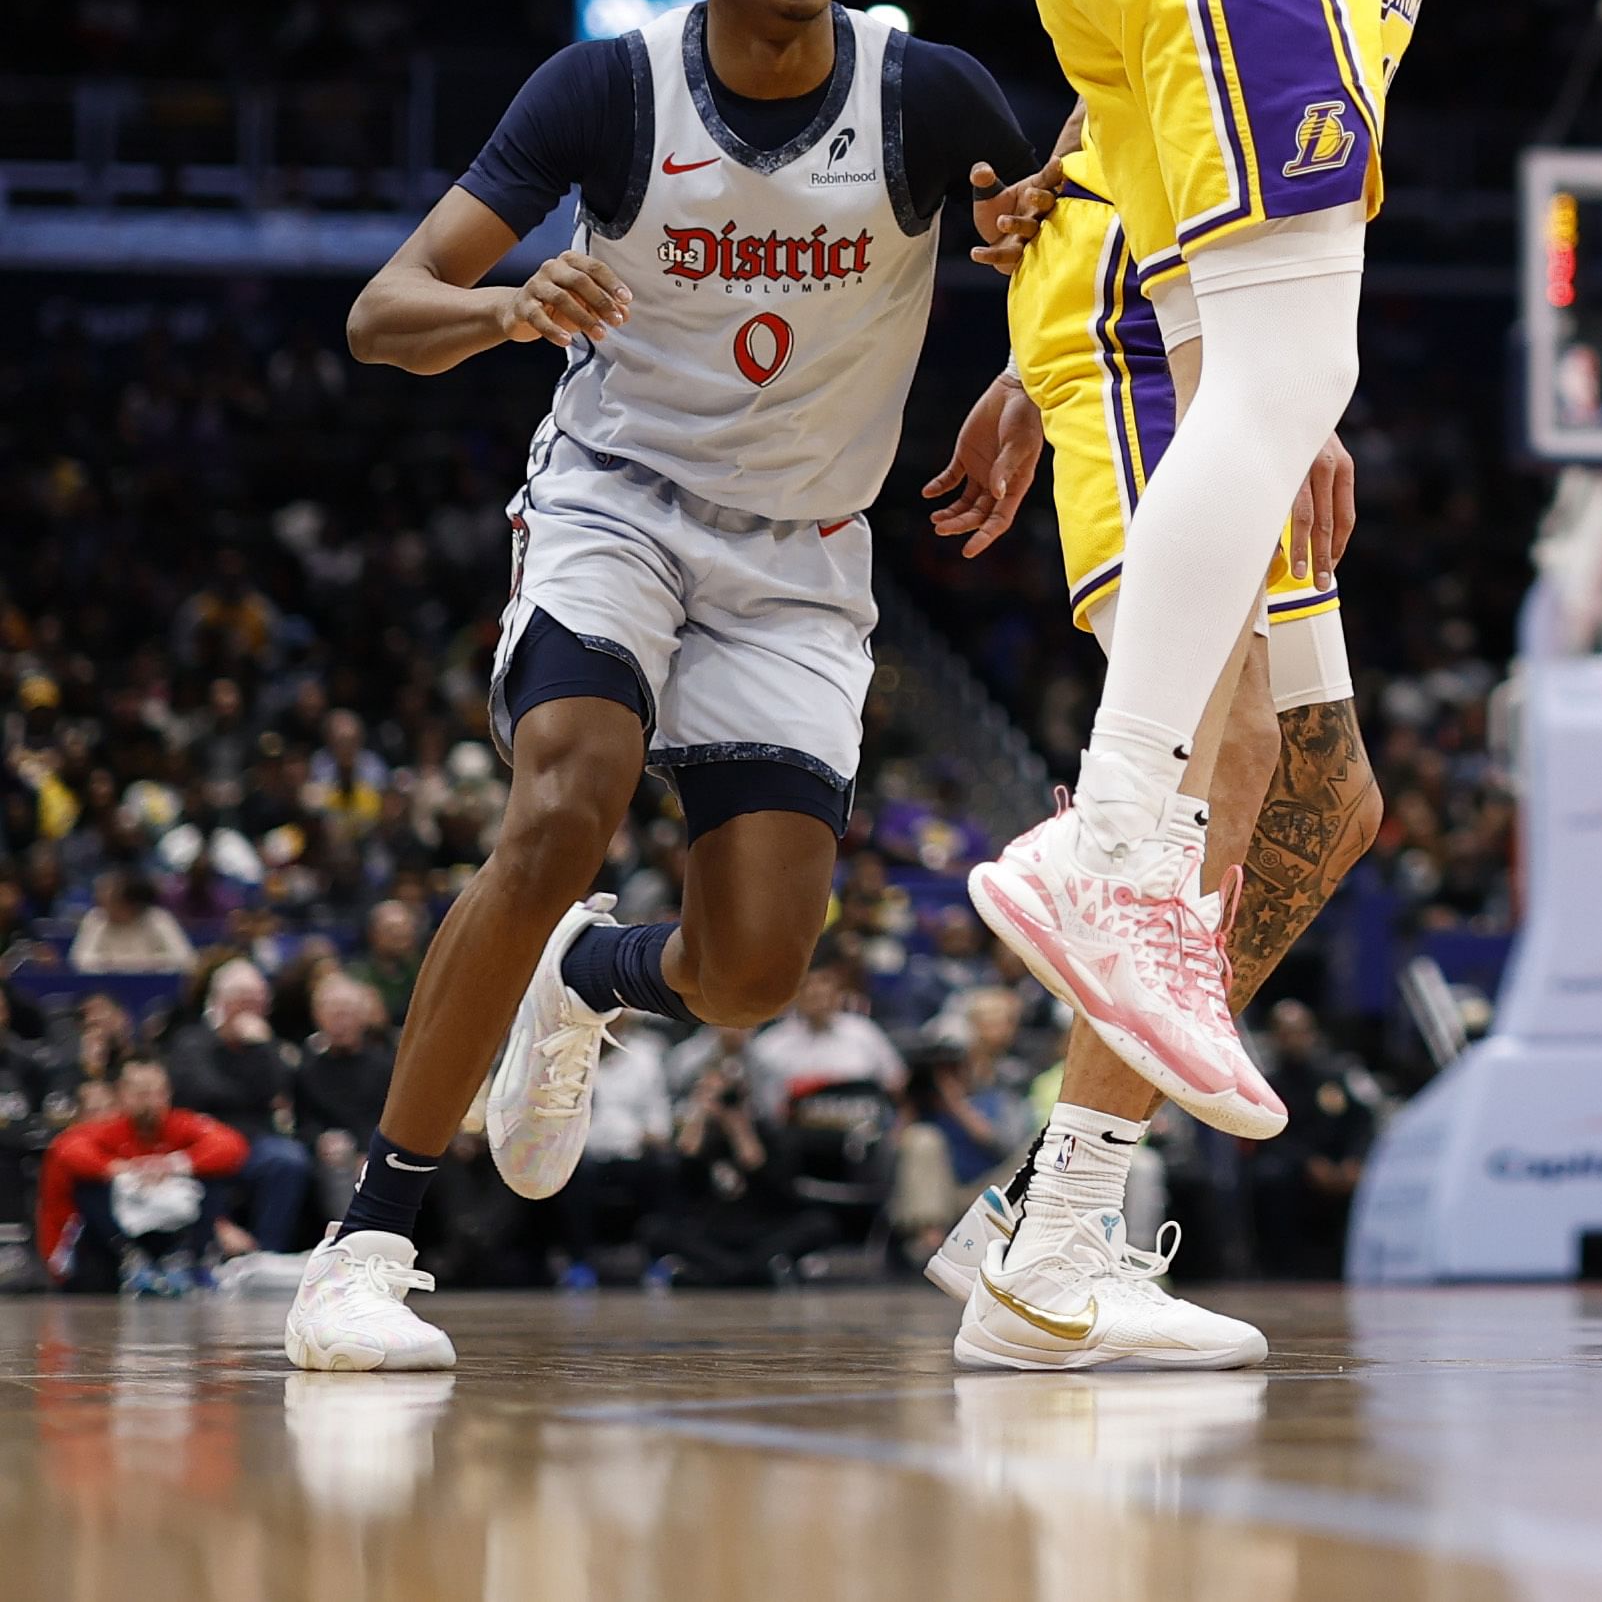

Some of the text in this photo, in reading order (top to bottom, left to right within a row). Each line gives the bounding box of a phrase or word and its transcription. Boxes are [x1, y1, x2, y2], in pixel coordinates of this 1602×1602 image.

[810, 170, 877, 185] Robinhood
[657, 219, 874, 282] the District
[675, 275, 863, 294] OF COLUMBIA
[733, 311, 795, 388] 0
